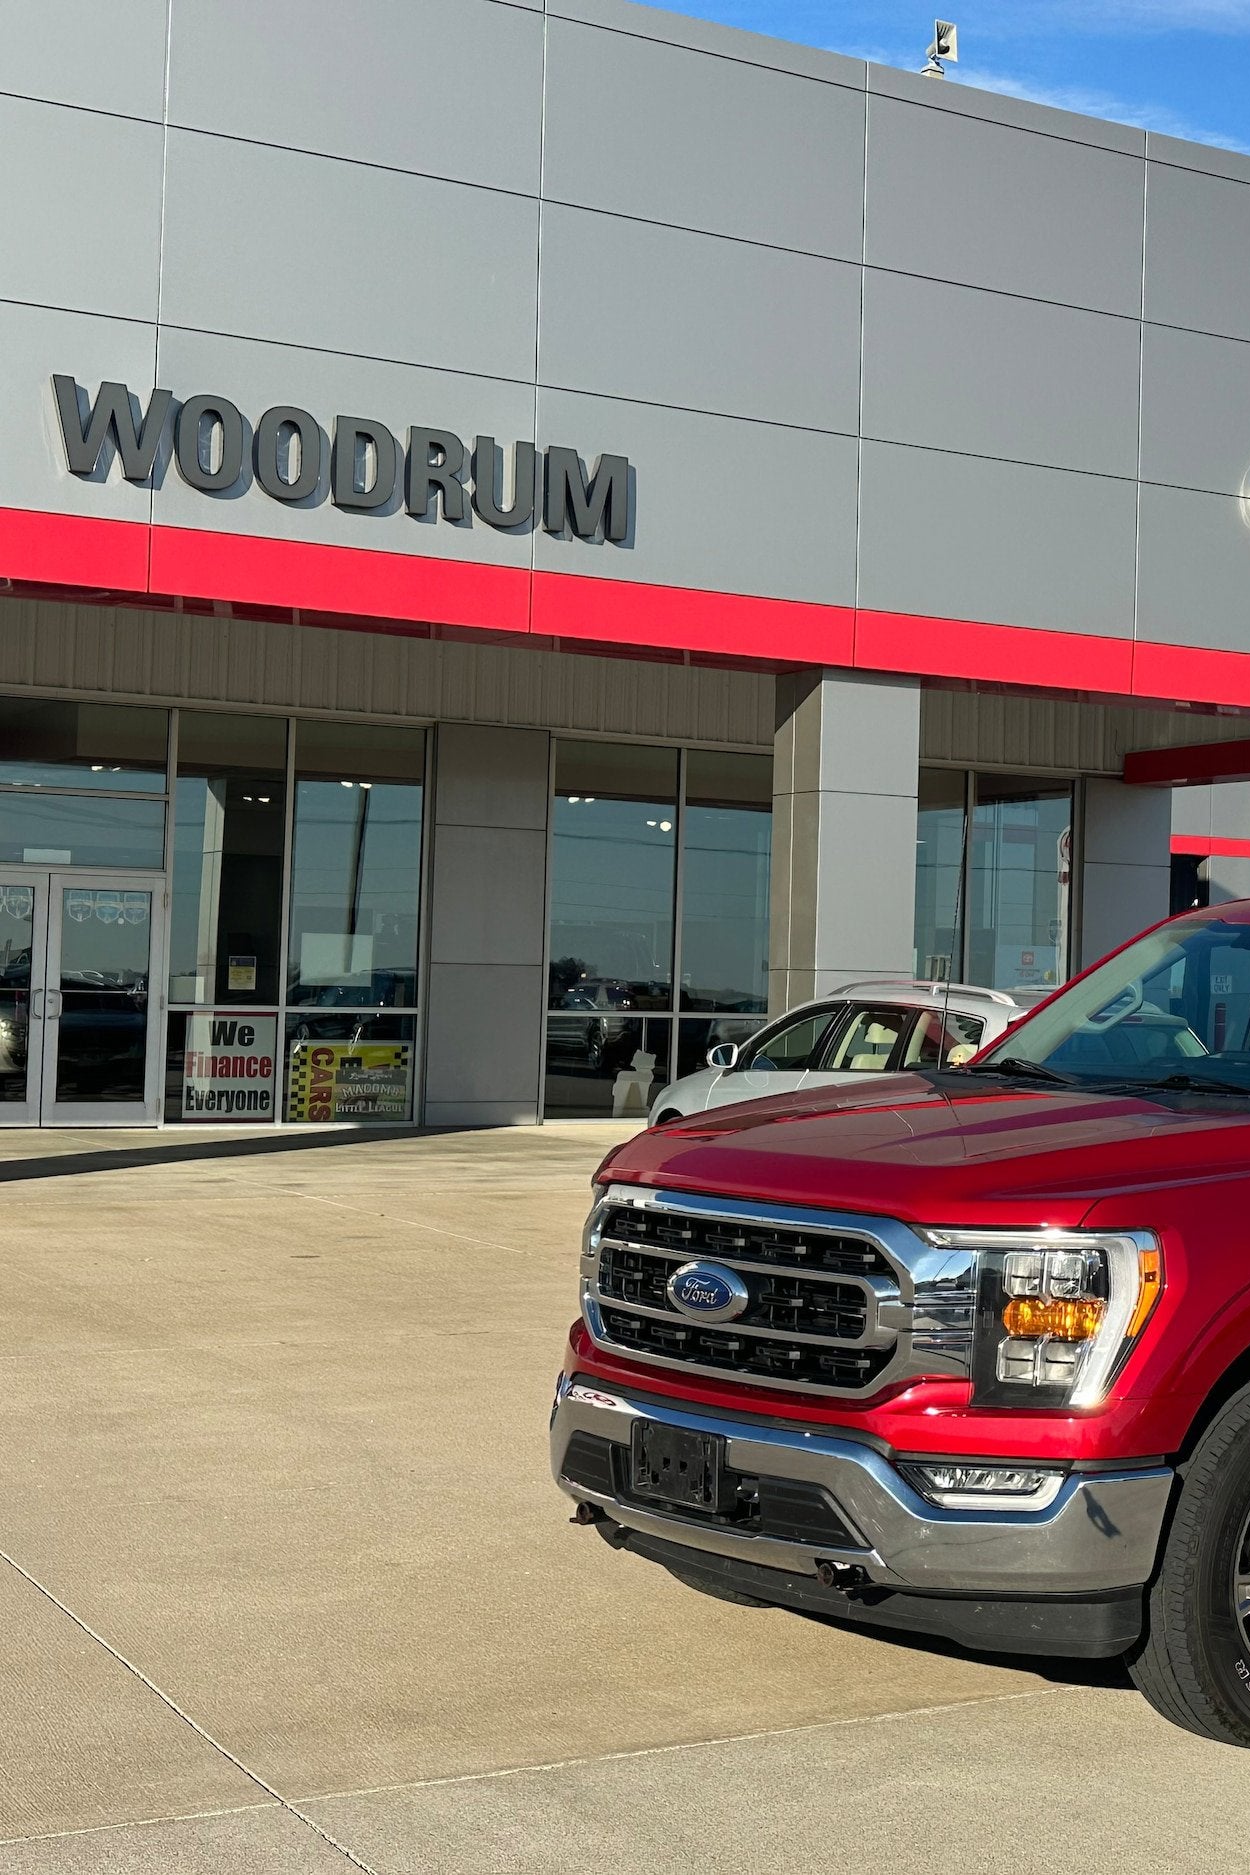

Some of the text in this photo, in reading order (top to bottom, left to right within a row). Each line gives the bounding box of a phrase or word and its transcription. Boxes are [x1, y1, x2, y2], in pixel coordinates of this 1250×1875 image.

[53, 373, 631, 542] WOODRUM
[210, 1020, 255, 1047] We
[185, 1051, 272, 1078] Finance
[308, 1047, 335, 1122] CARS
[185, 1085, 270, 1114] Everyone
[681, 1277, 719, 1305] Ford
